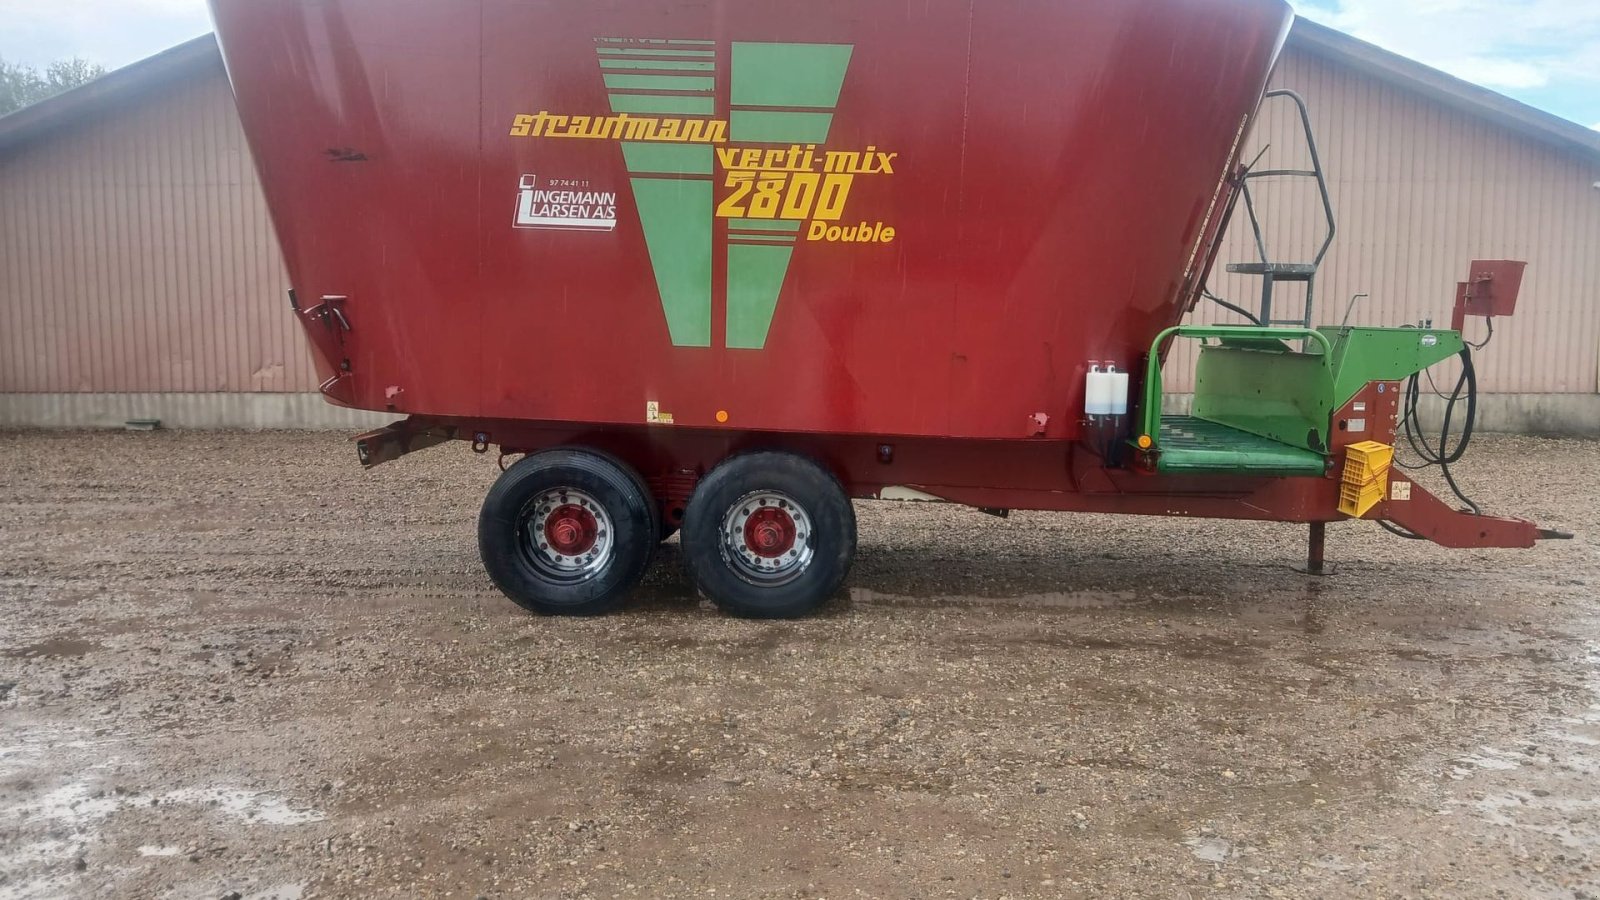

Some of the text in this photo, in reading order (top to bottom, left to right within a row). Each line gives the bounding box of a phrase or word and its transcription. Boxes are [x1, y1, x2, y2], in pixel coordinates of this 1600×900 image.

[715, 144, 898, 174] verti-mix
[549, 179, 559, 187] 97
[560, 179, 569, 187] 74
[715, 171, 854, 220] 2800
[531, 203, 617, 219] LARSEN A/S
[806, 220, 896, 243] Double
